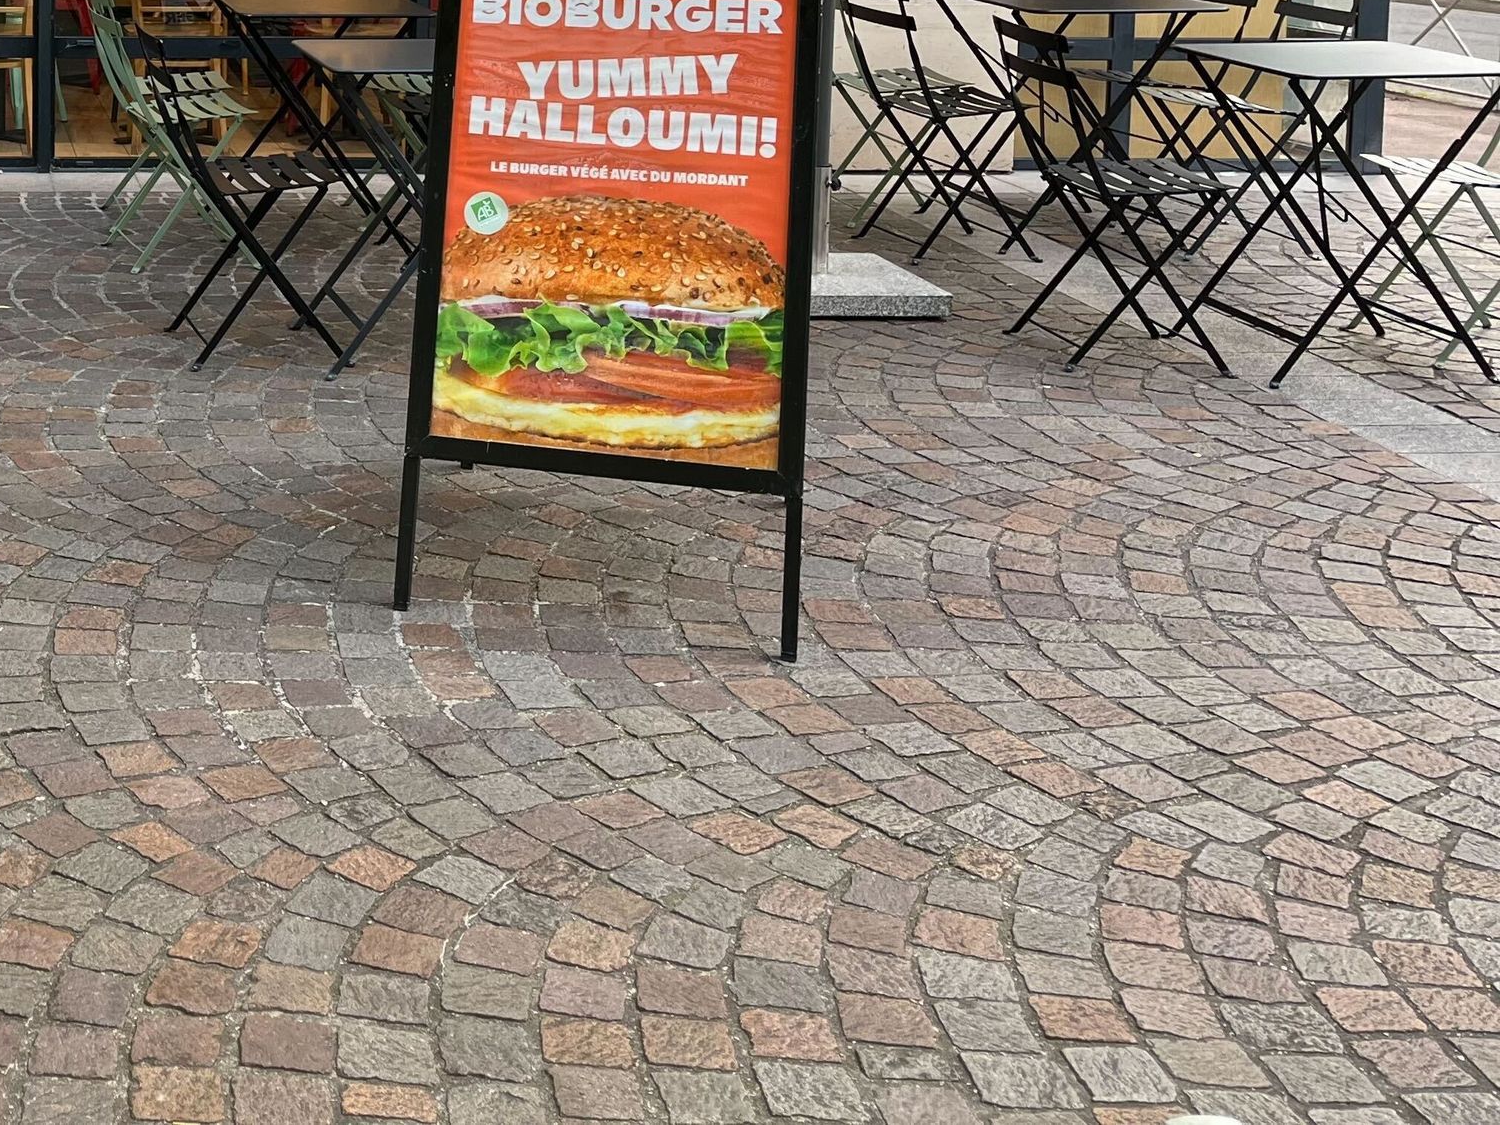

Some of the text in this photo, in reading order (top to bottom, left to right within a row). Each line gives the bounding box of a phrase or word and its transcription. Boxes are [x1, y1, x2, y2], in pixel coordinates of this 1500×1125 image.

[517, 53, 739, 100] YUMMY
[468, 95, 777, 159] HALLOUMI!
[490, 161, 749, 187] LE BURGER VÉGÉ AVEC DU MORDANT
